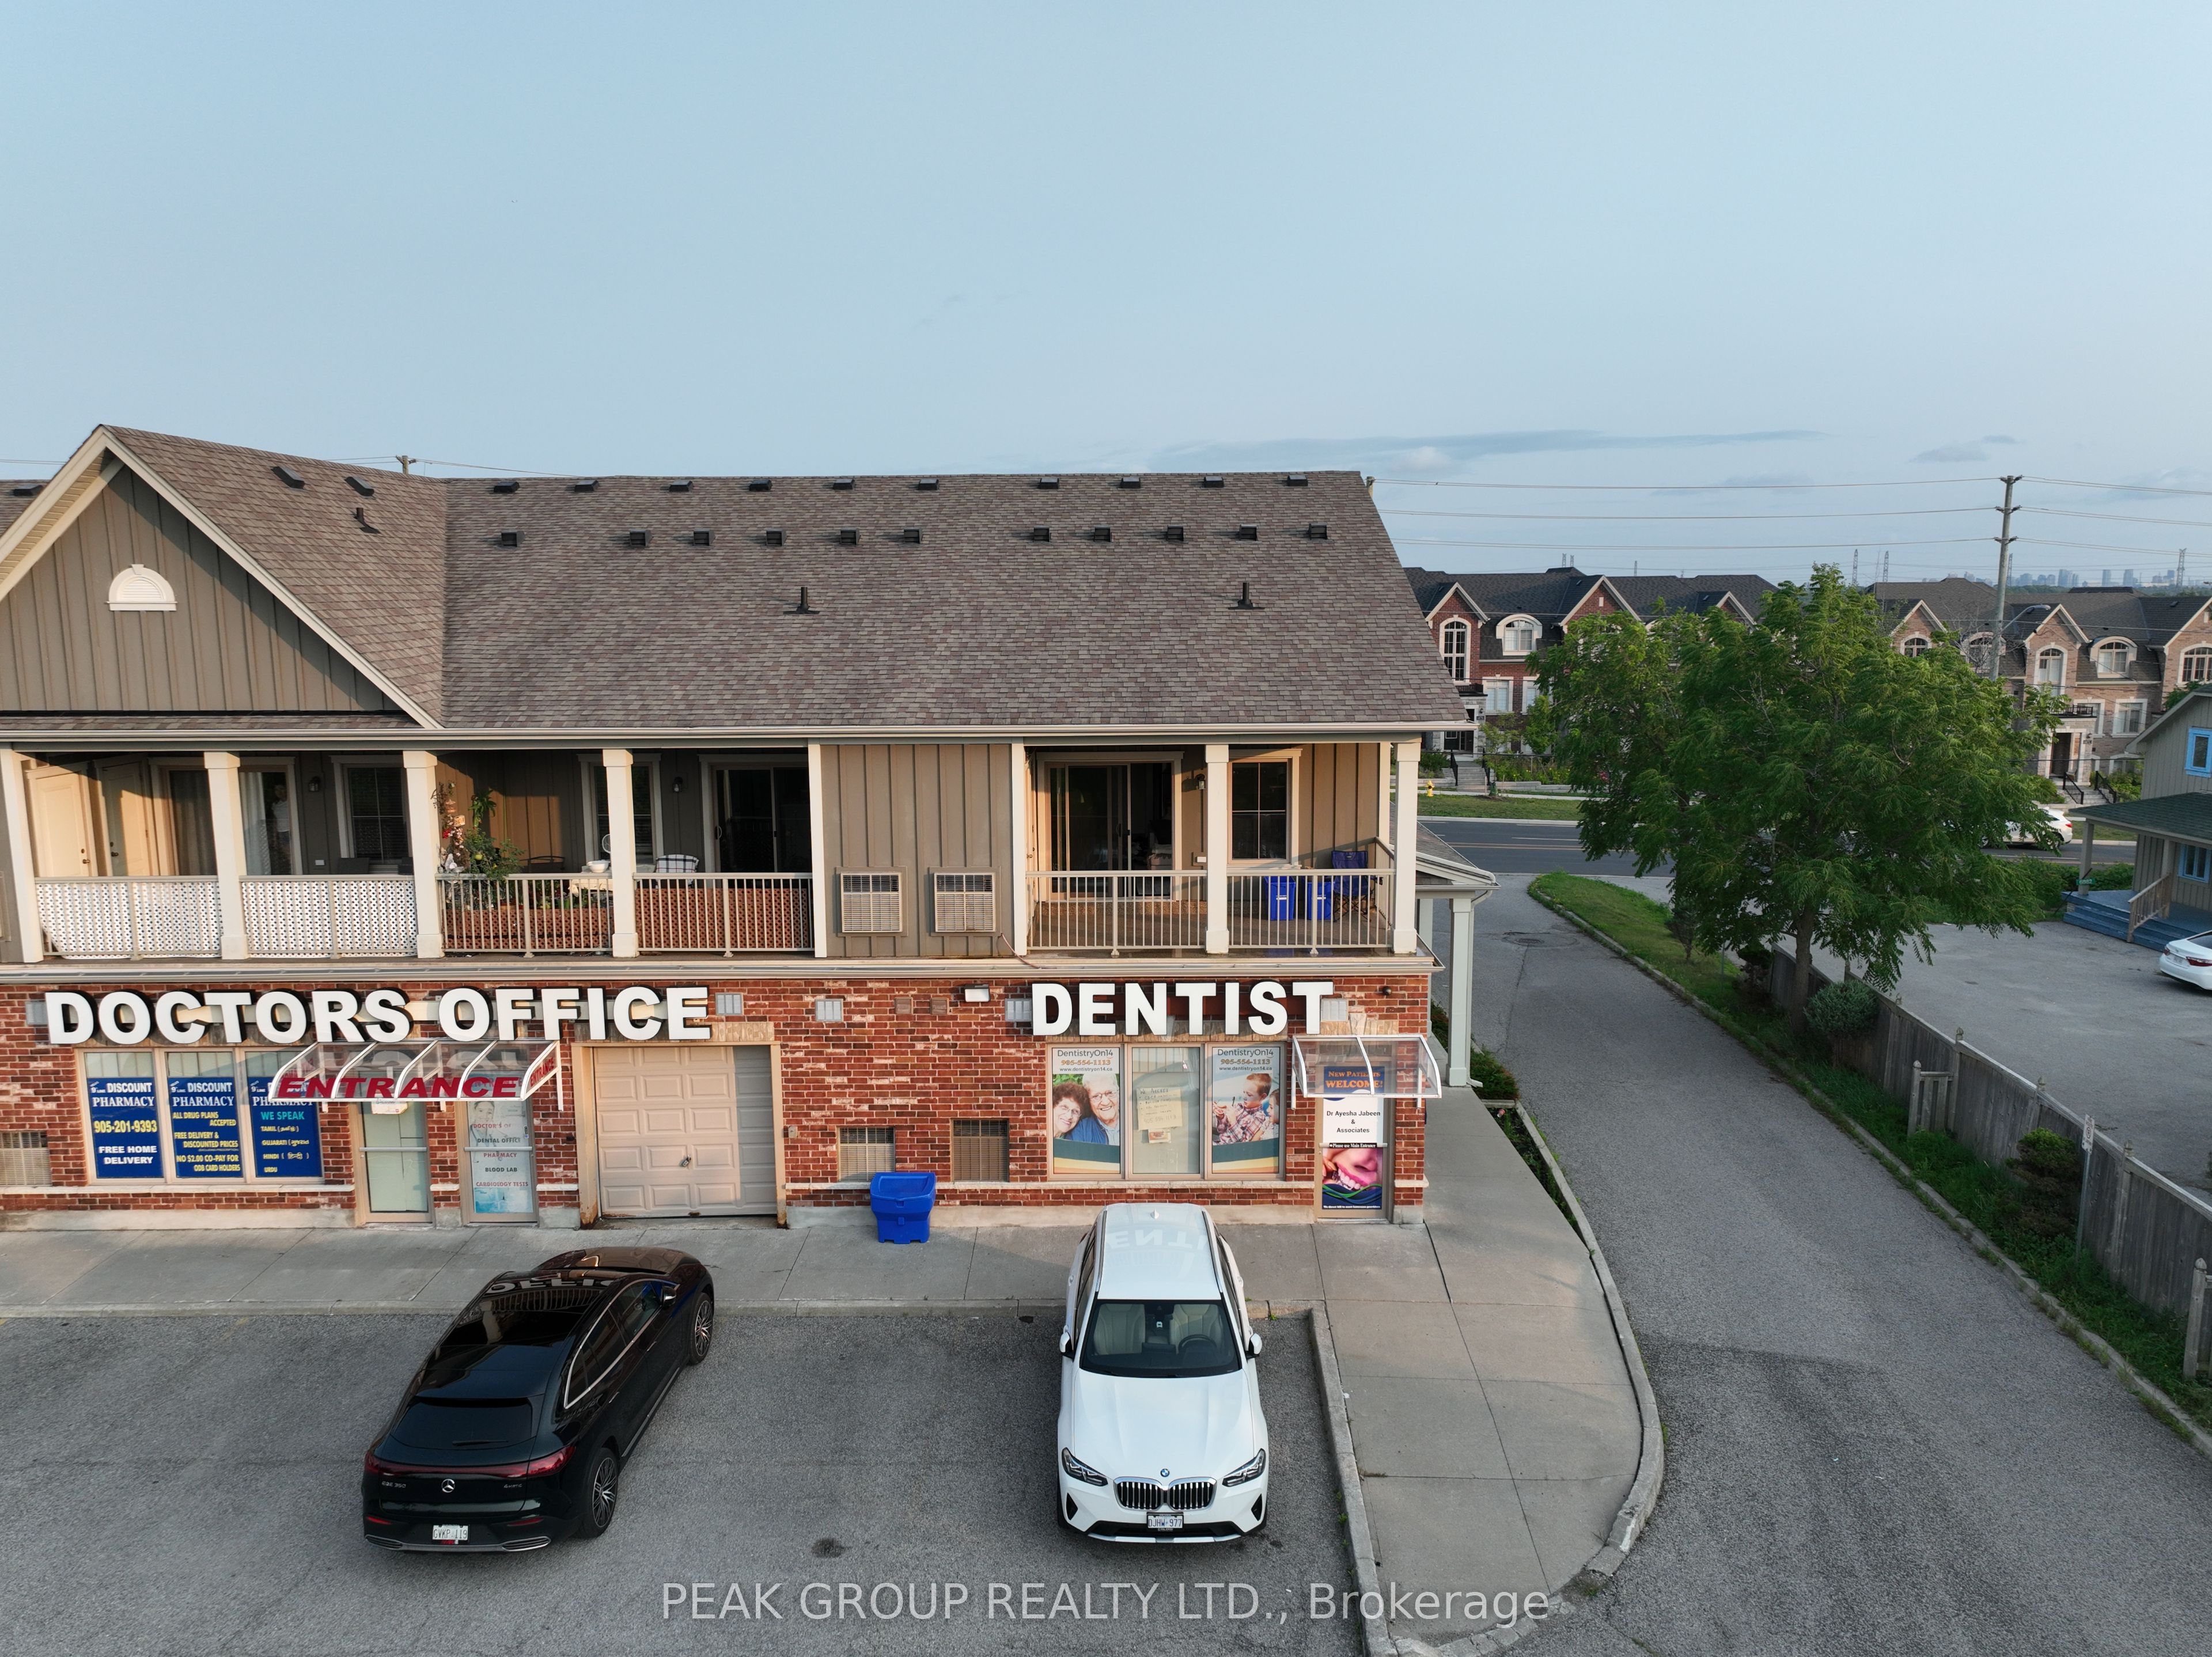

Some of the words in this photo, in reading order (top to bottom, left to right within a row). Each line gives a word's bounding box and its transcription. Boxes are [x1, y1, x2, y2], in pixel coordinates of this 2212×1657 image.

[1032, 981, 1334, 1036] DENTIST
[46, 988, 411, 1044] DOCTORS
[438, 987, 711, 1041] OFFICE
[1058, 1049, 1113, 1057] DentistryOn14
[1218, 1049, 1274, 1057] DentistryOn14
[106, 1082, 152, 1093] DISCOUNT
[187, 1082, 232, 1093] DISCOUNT
[278, 1077, 519, 1098] ENTRANCE
[92, 1096, 154, 1107] PHARMACY
[172, 1096, 234, 1106] PHARMACY
[260, 1112, 275, 1120] WE
[276, 1111, 305, 1120] SPEAK
[94, 1120, 157, 1133] 905-201-9393
[98, 1146, 125, 1154] FREE
[127, 1145, 157, 1153] HOME
[103, 1157, 154, 1165] DELIVERY
[1169, 1519, 1182, 1527] 977
[455, 1530, 467, 1538] 119
